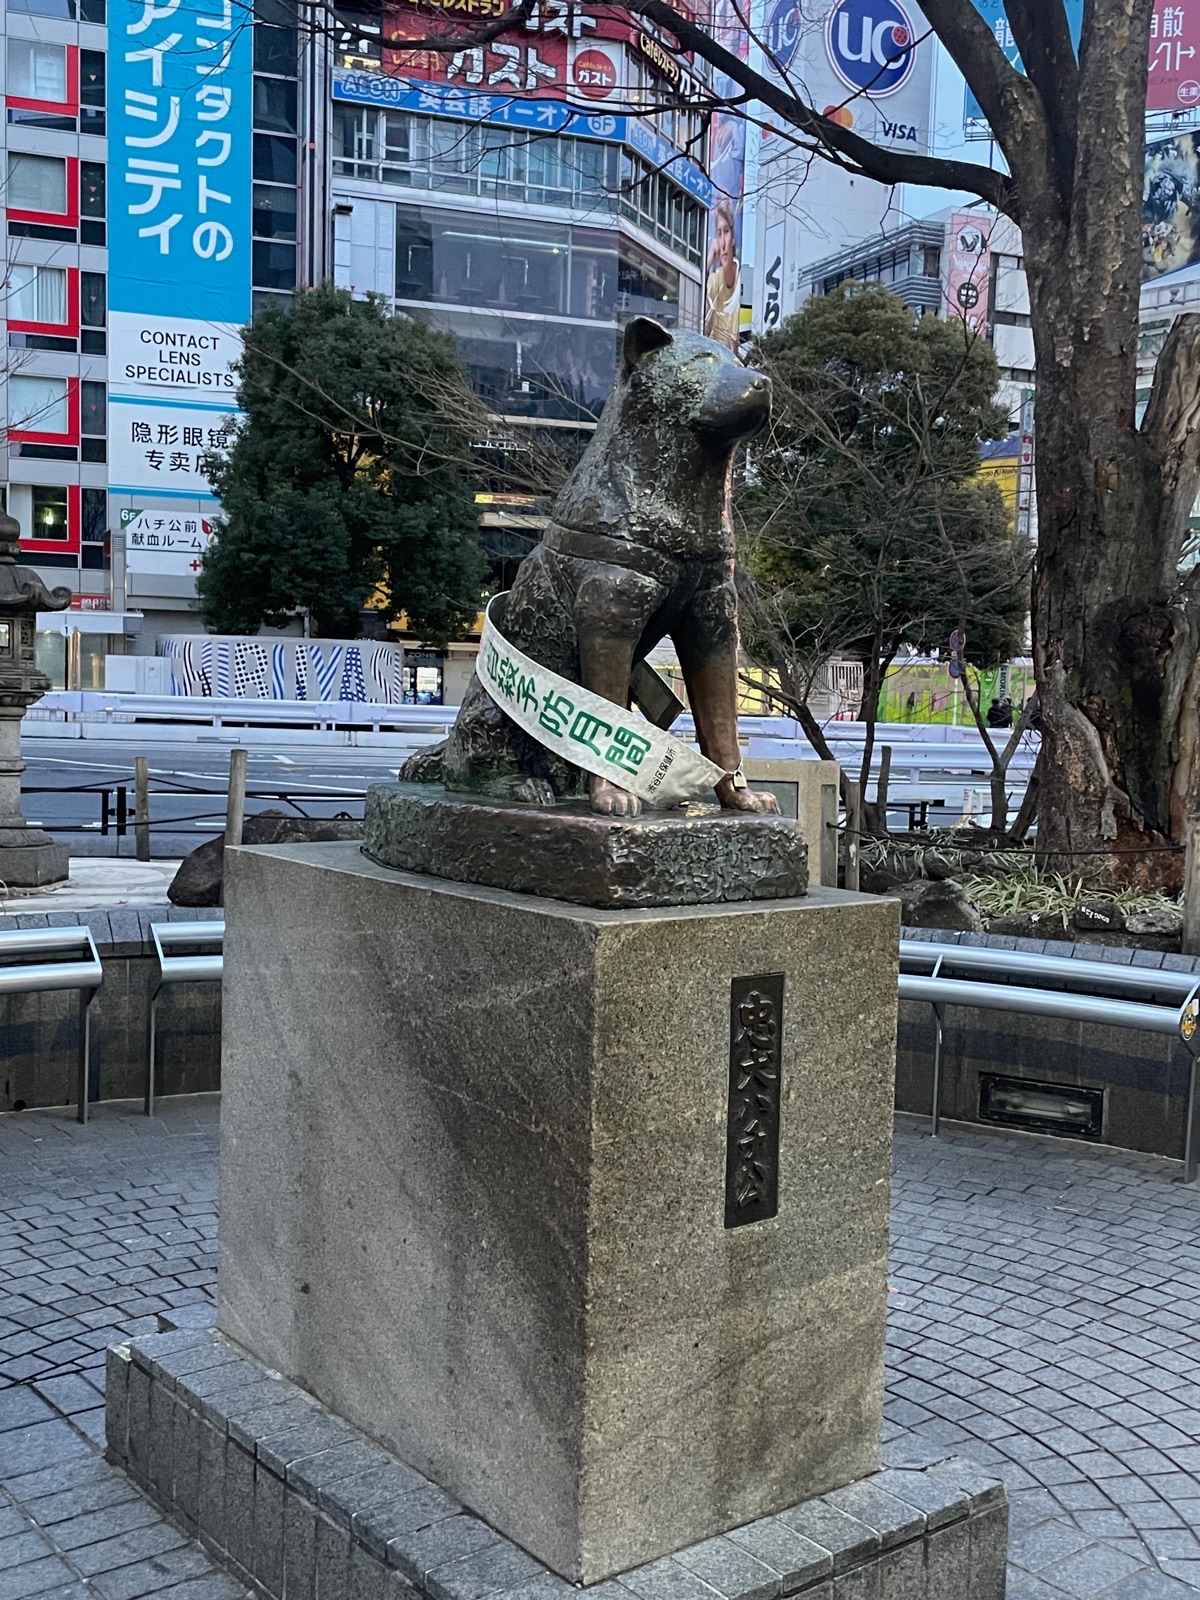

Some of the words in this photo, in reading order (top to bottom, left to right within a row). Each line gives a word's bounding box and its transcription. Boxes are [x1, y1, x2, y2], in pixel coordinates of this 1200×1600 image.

[838, 12, 906, 70] UC
[578, 70, 612, 86] ガスト
[881, 121, 917, 142] VISA
[140, 330, 220, 350] CONTACT
[159, 350, 201, 366] LENS
[125, 365, 234, 387] SPECIALISTS
[131, 422, 229, 449] 隐形眼镜
[121, 510, 136, 521] 6F
[137, 518, 197, 533] ハチ公前
[131, 533, 202, 548] 献血ルーム
[487, 641, 652, 776] 自殺予防月間
[648, 746, 677, 794] 渋谷区保健所
[734, 989, 776, 1206] 忠犬ハチ公
